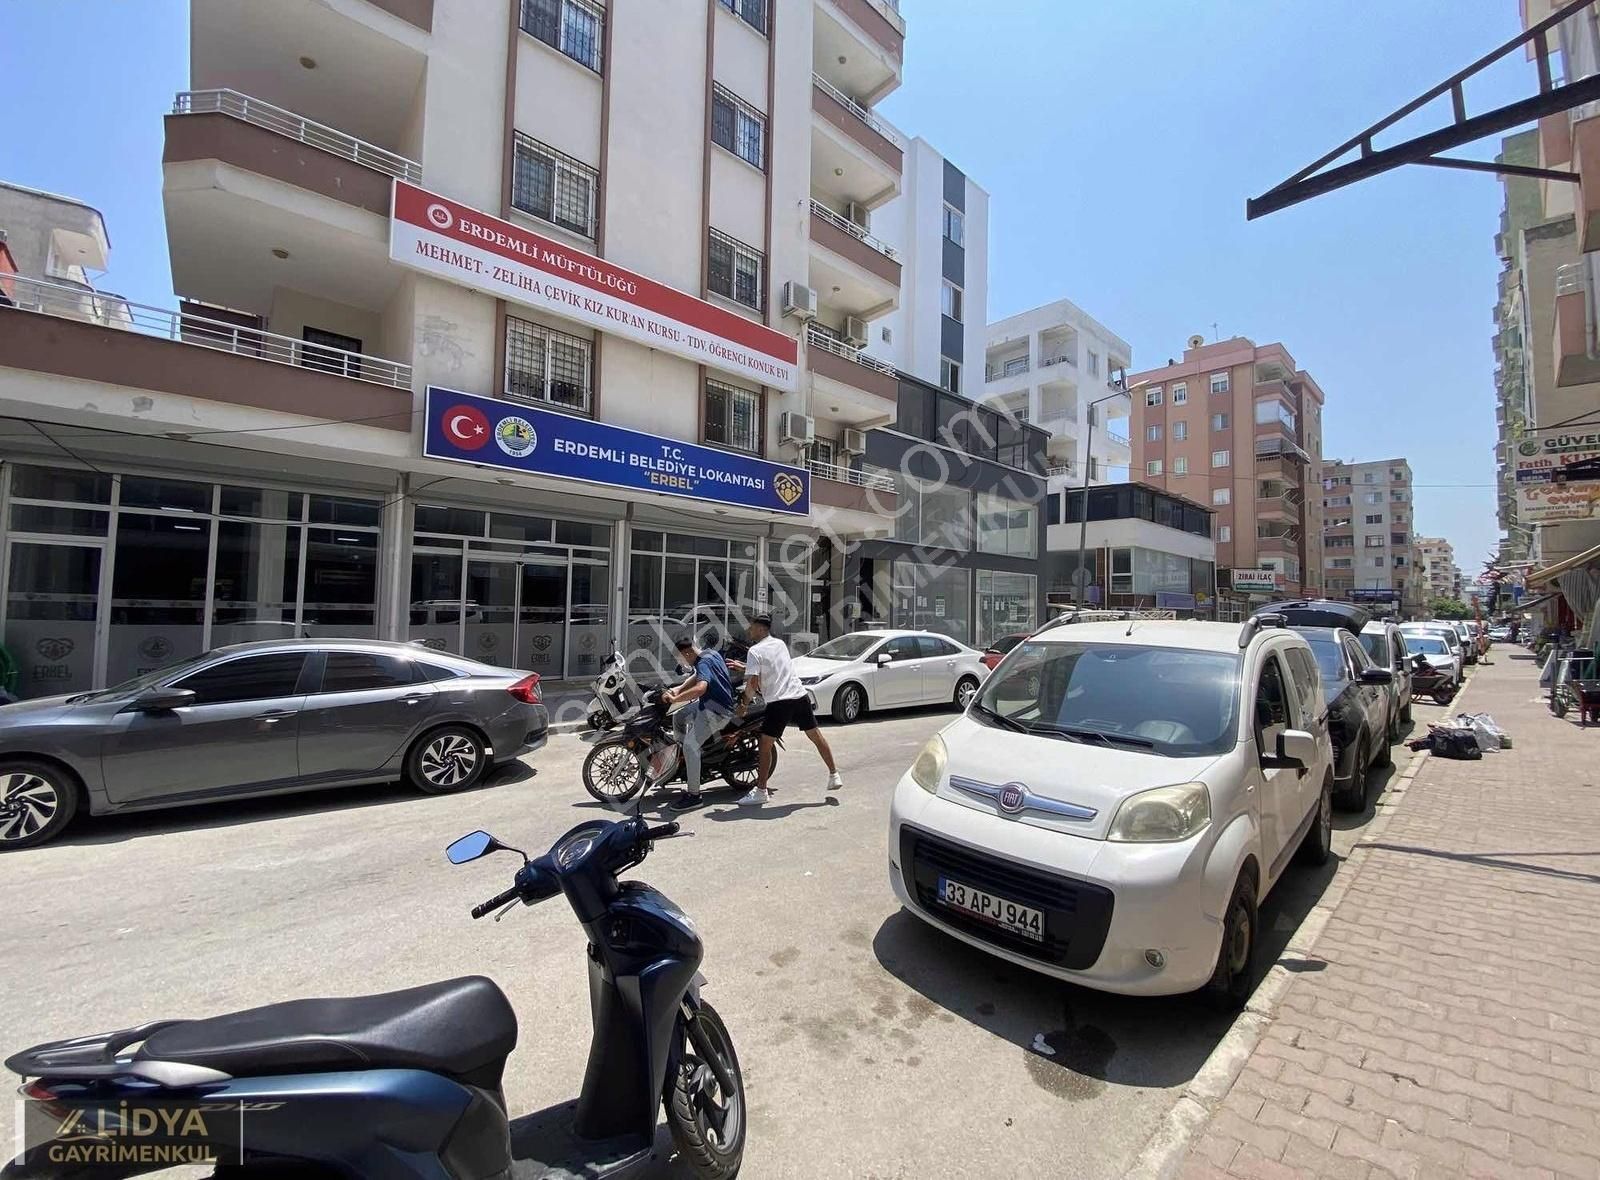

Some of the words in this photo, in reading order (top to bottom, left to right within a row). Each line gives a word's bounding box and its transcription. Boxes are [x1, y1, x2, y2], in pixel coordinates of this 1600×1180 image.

[459, 219, 538, 259] ERDEMLİ
[541, 250, 637, 296] MÜFTÜLÜĞÜ
[416, 240, 483, 274] MEHMET
[493, 266, 541, 294] ZELİHA
[545, 285, 581, 307] ÇEVİK
[584, 298, 603, 316] KIZ
[606, 306, 645, 329] KUR'AN
[647, 321, 680, 342] KURSU
[709, 340, 747, 365] ÖĞRENCİ
[748, 358, 775, 376] KONUK
[776, 366, 789, 381] EVİ
[1544, 434, 1600, 448] GÜVE
[661, 445, 685, 461] T.C.
[699, 467, 765, 490] LOKANTASI
[1004, 791, 1018, 804] FIAT
[947, 882, 966, 906] 33
[970, 892, 1002, 919] APJ
[1006, 904, 1041, 933] 944
